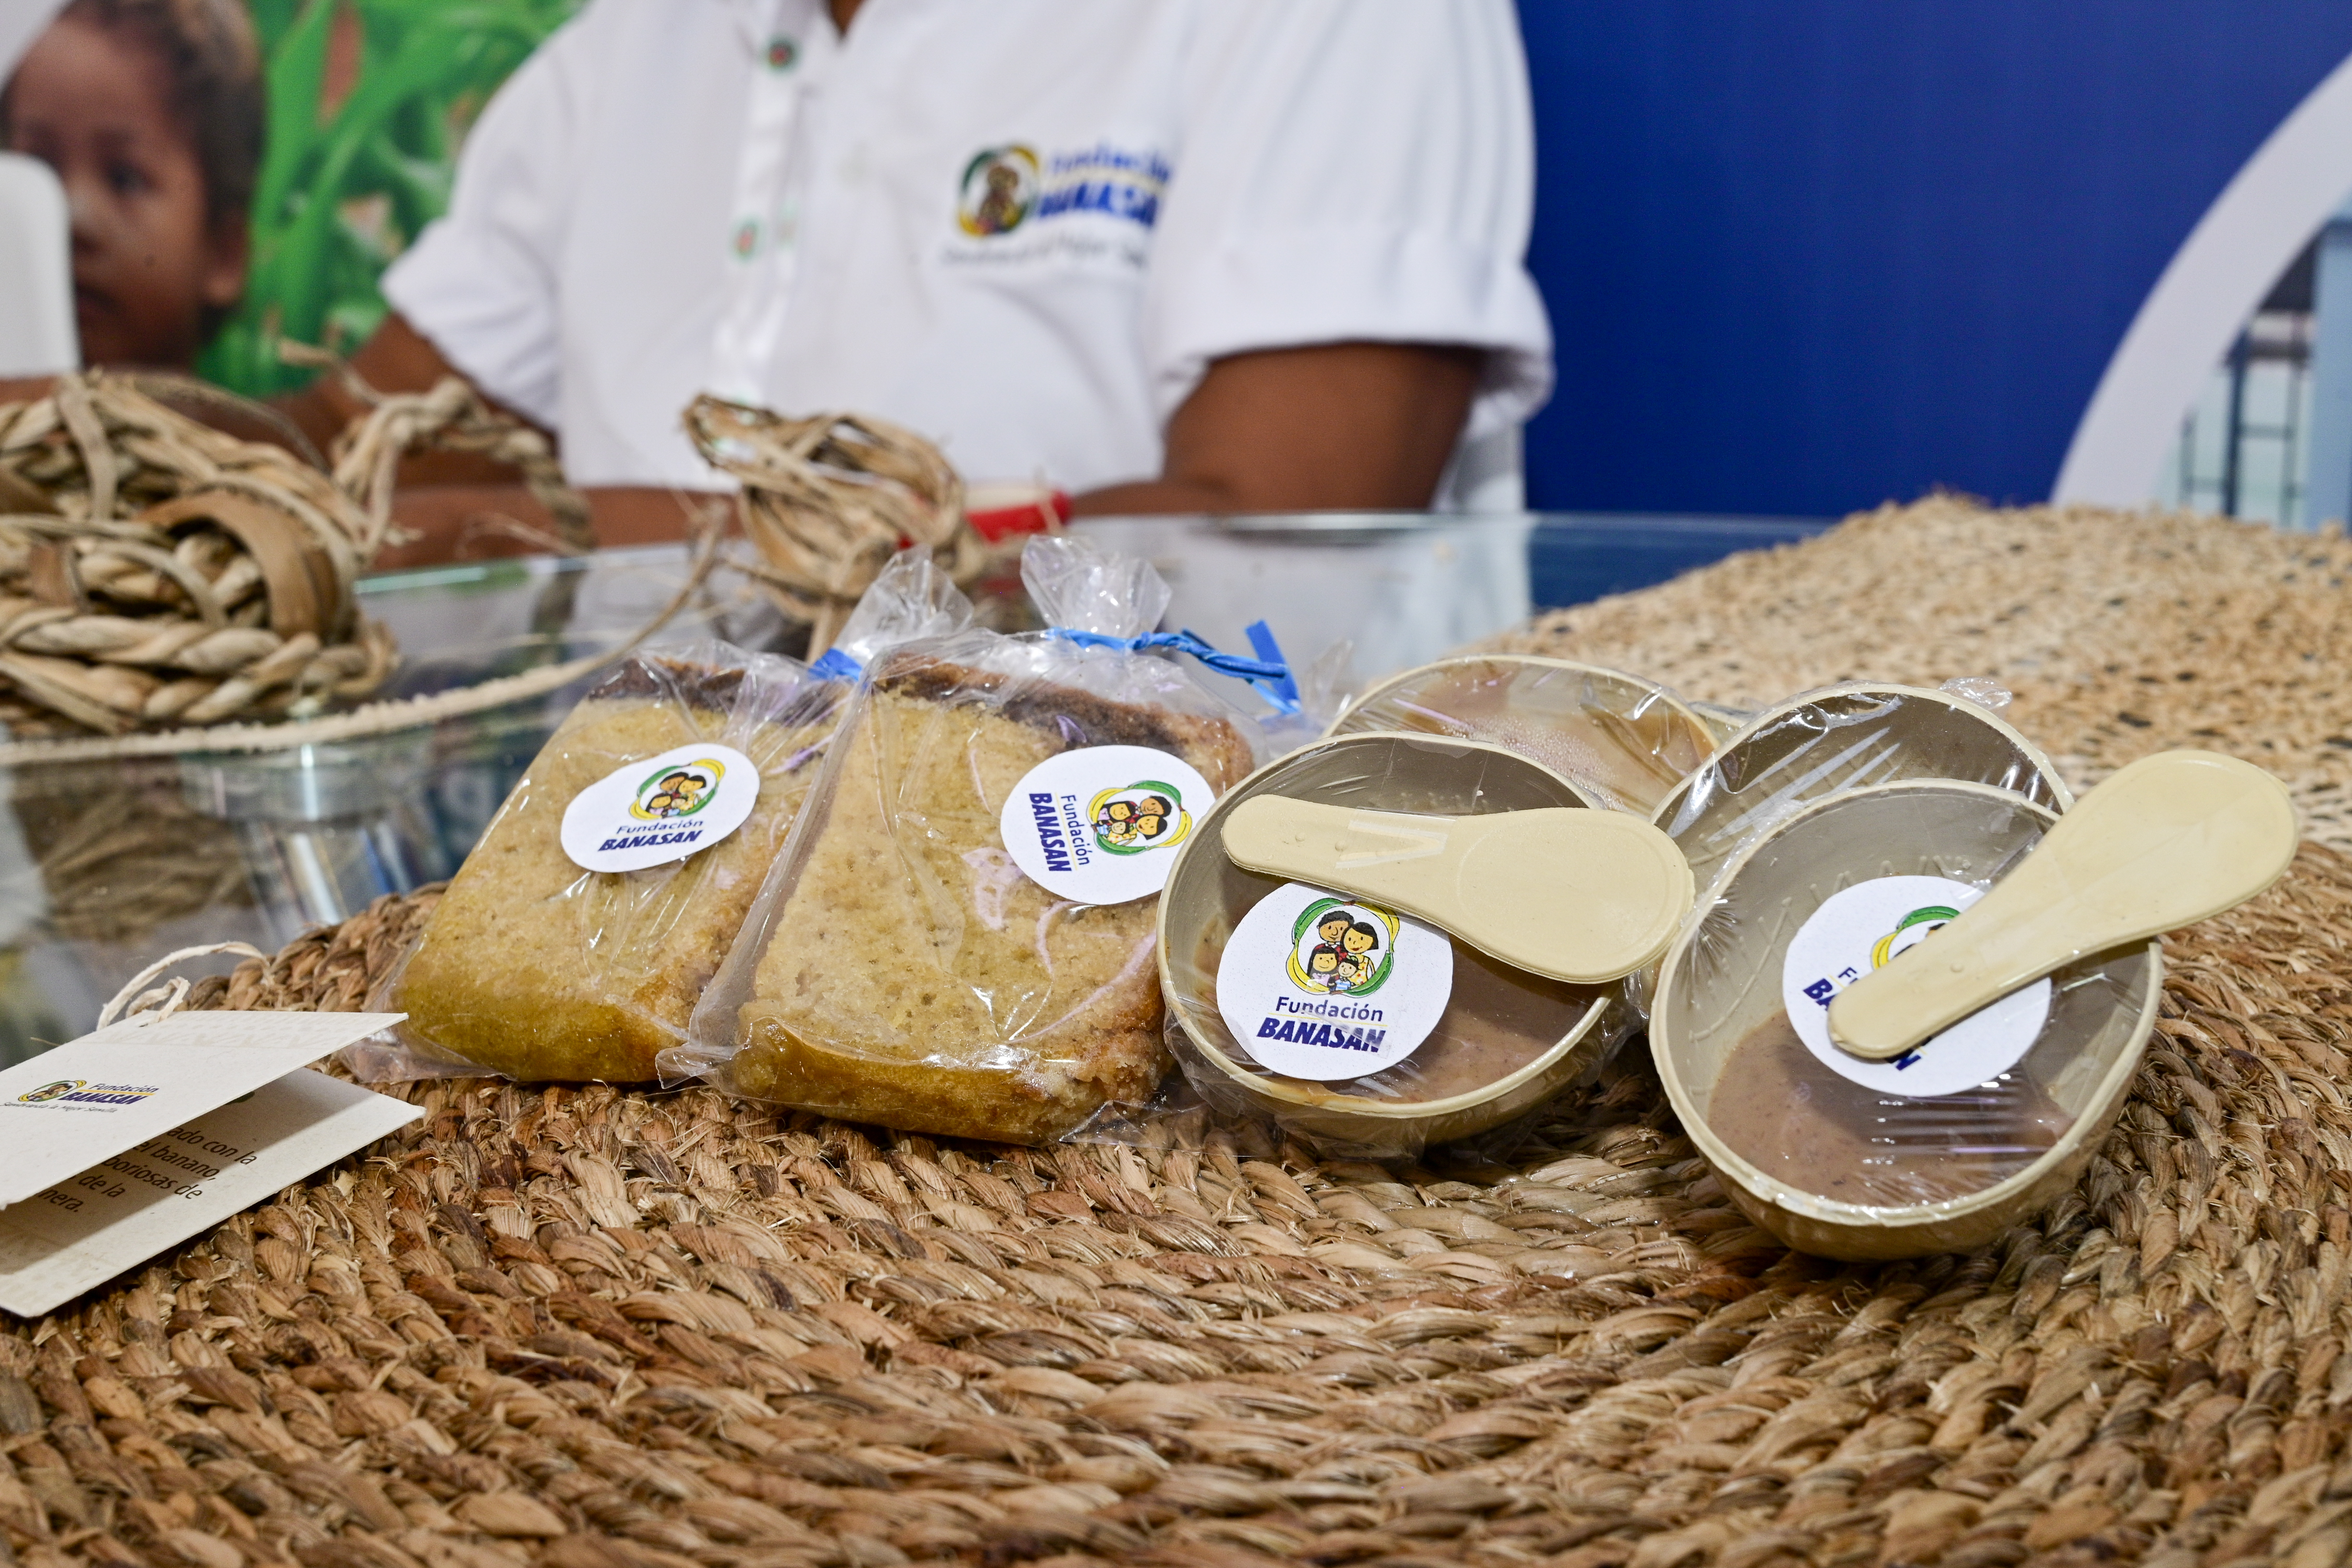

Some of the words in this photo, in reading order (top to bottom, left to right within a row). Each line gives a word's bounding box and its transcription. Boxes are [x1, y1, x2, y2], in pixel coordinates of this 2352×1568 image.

[616, 819, 704, 835] Fundación
[1028, 793, 1072, 872] BANASAN
[1060, 794, 1091, 865] Fundación
[597, 829, 704, 852] BANASAN
[1275, 996, 1383, 1022] Fundación
[1256, 1017, 1386, 1052] BANASAN
[57, 1092, 149, 1105] BANASAN
[88, 1083, 160, 1093] Fundación
[166, 1127, 204, 1144] ado
[202, 1141, 238, 1157] con
[234, 1150, 257, 1165] la
[150, 1145, 220, 1181] banano,
[79, 1174, 106, 1190] de
[101, 1183, 125, 1197] la
[101, 1154, 178, 1189] boriosas
[174, 1184, 203, 1199] de
[38, 1189, 84, 1212] nera.
